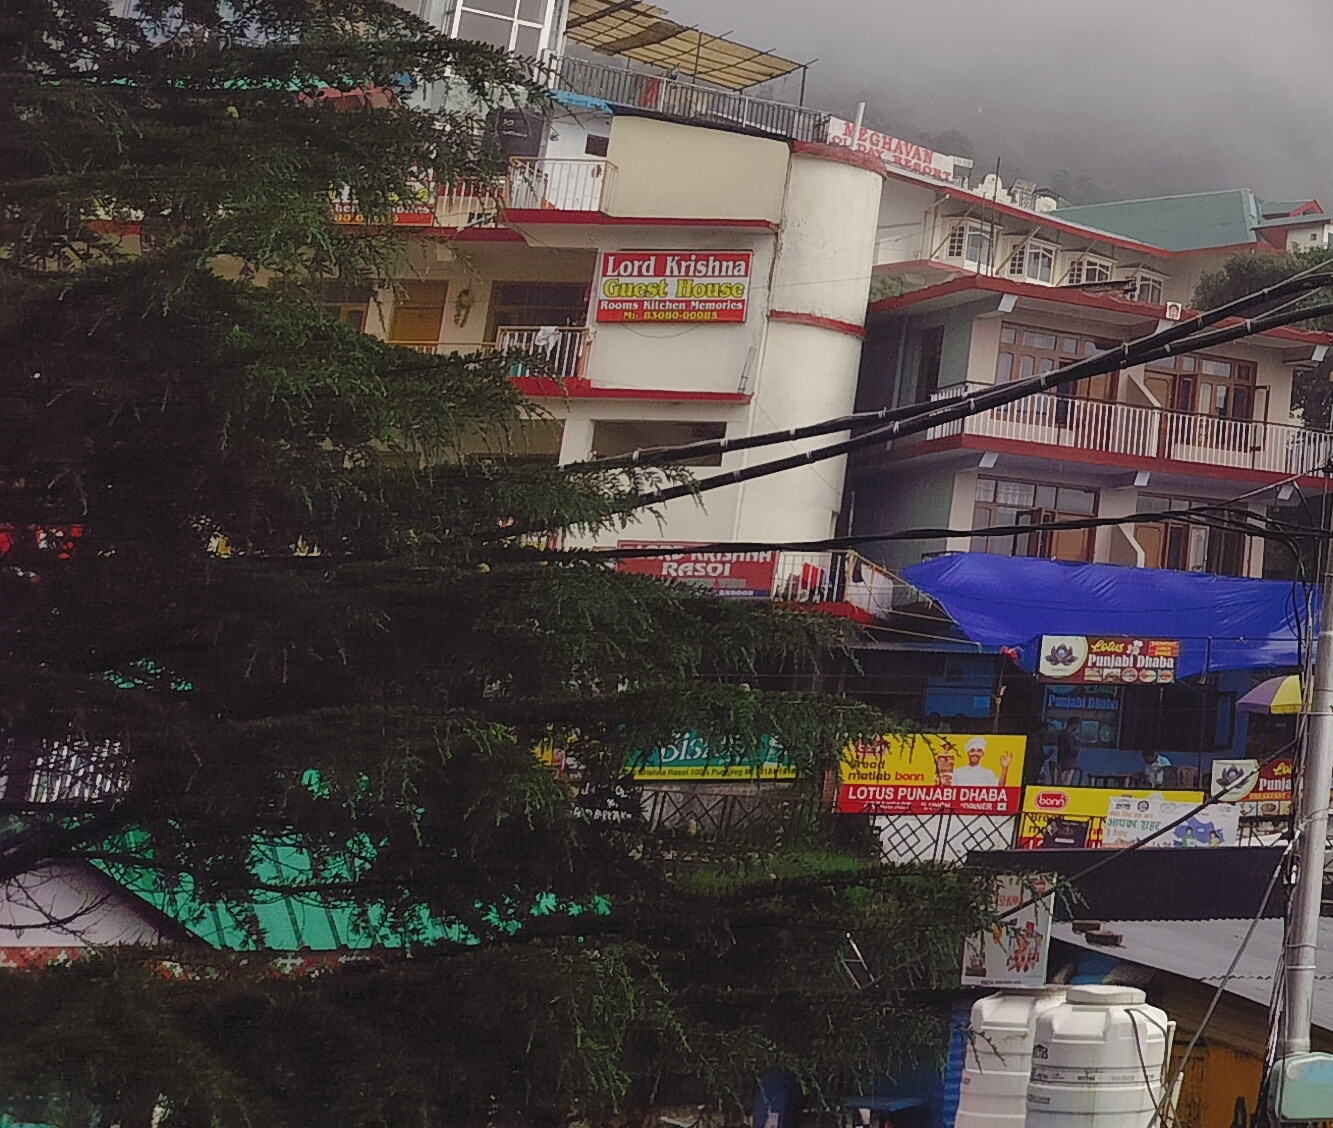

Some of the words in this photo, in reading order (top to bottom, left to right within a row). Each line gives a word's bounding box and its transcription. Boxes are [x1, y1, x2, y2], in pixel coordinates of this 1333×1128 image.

[843, 122, 933, 165] MEGHAVAN
[892, 154, 953, 181] RESORT
[606, 255, 656, 276] Lord
[664, 255, 746, 276] Krishna
[603, 278, 669, 298] Guest
[675, 279, 745, 299] House
[600, 300, 638, 310] Rooms
[643, 300, 686, 310] Kitchen
[690, 300, 743, 310] Memories
[661, 562, 731, 577] RASOI
[1091, 640, 1124, 652] Lotus
[1088, 654, 1134, 668] Punjabi
[1136, 655, 1174, 668] Dhaba
[1048, 694, 1085, 708] Punjabi
[1088, 697, 1118, 710] Dhaba
[851, 759, 885, 769] read
[848, 770, 891, 781] matlab
[894, 771, 924, 781] bonn
[848, 786, 894, 800] LOTUS
[897, 787, 956, 801] PUNJABI
[959, 788, 1007, 801] DHABA
[1038, 793, 1065, 808] bonn
